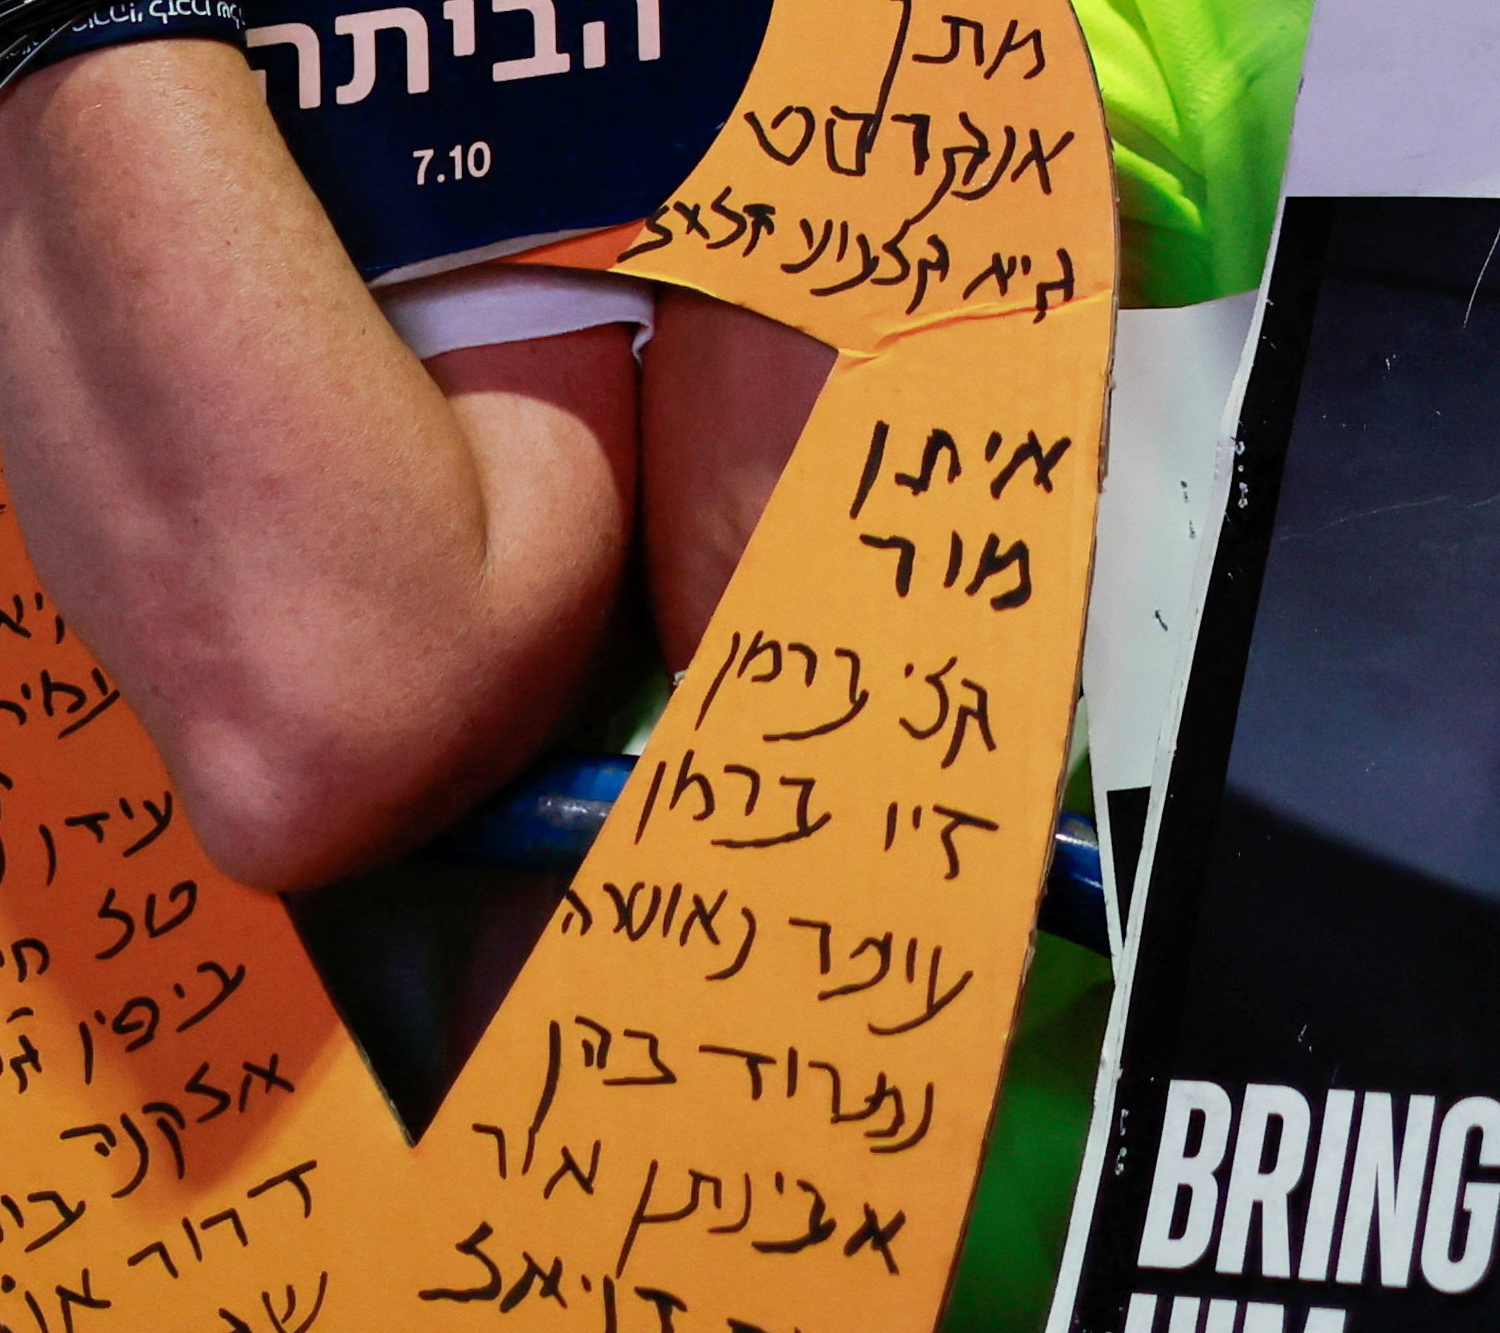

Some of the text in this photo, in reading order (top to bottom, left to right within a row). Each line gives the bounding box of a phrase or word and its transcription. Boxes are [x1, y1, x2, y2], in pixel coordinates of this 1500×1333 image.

[412, 140, 492, 185] 7.10
[849, 420, 1073, 520] איתן
[859, 531, 1033, 612] מור
